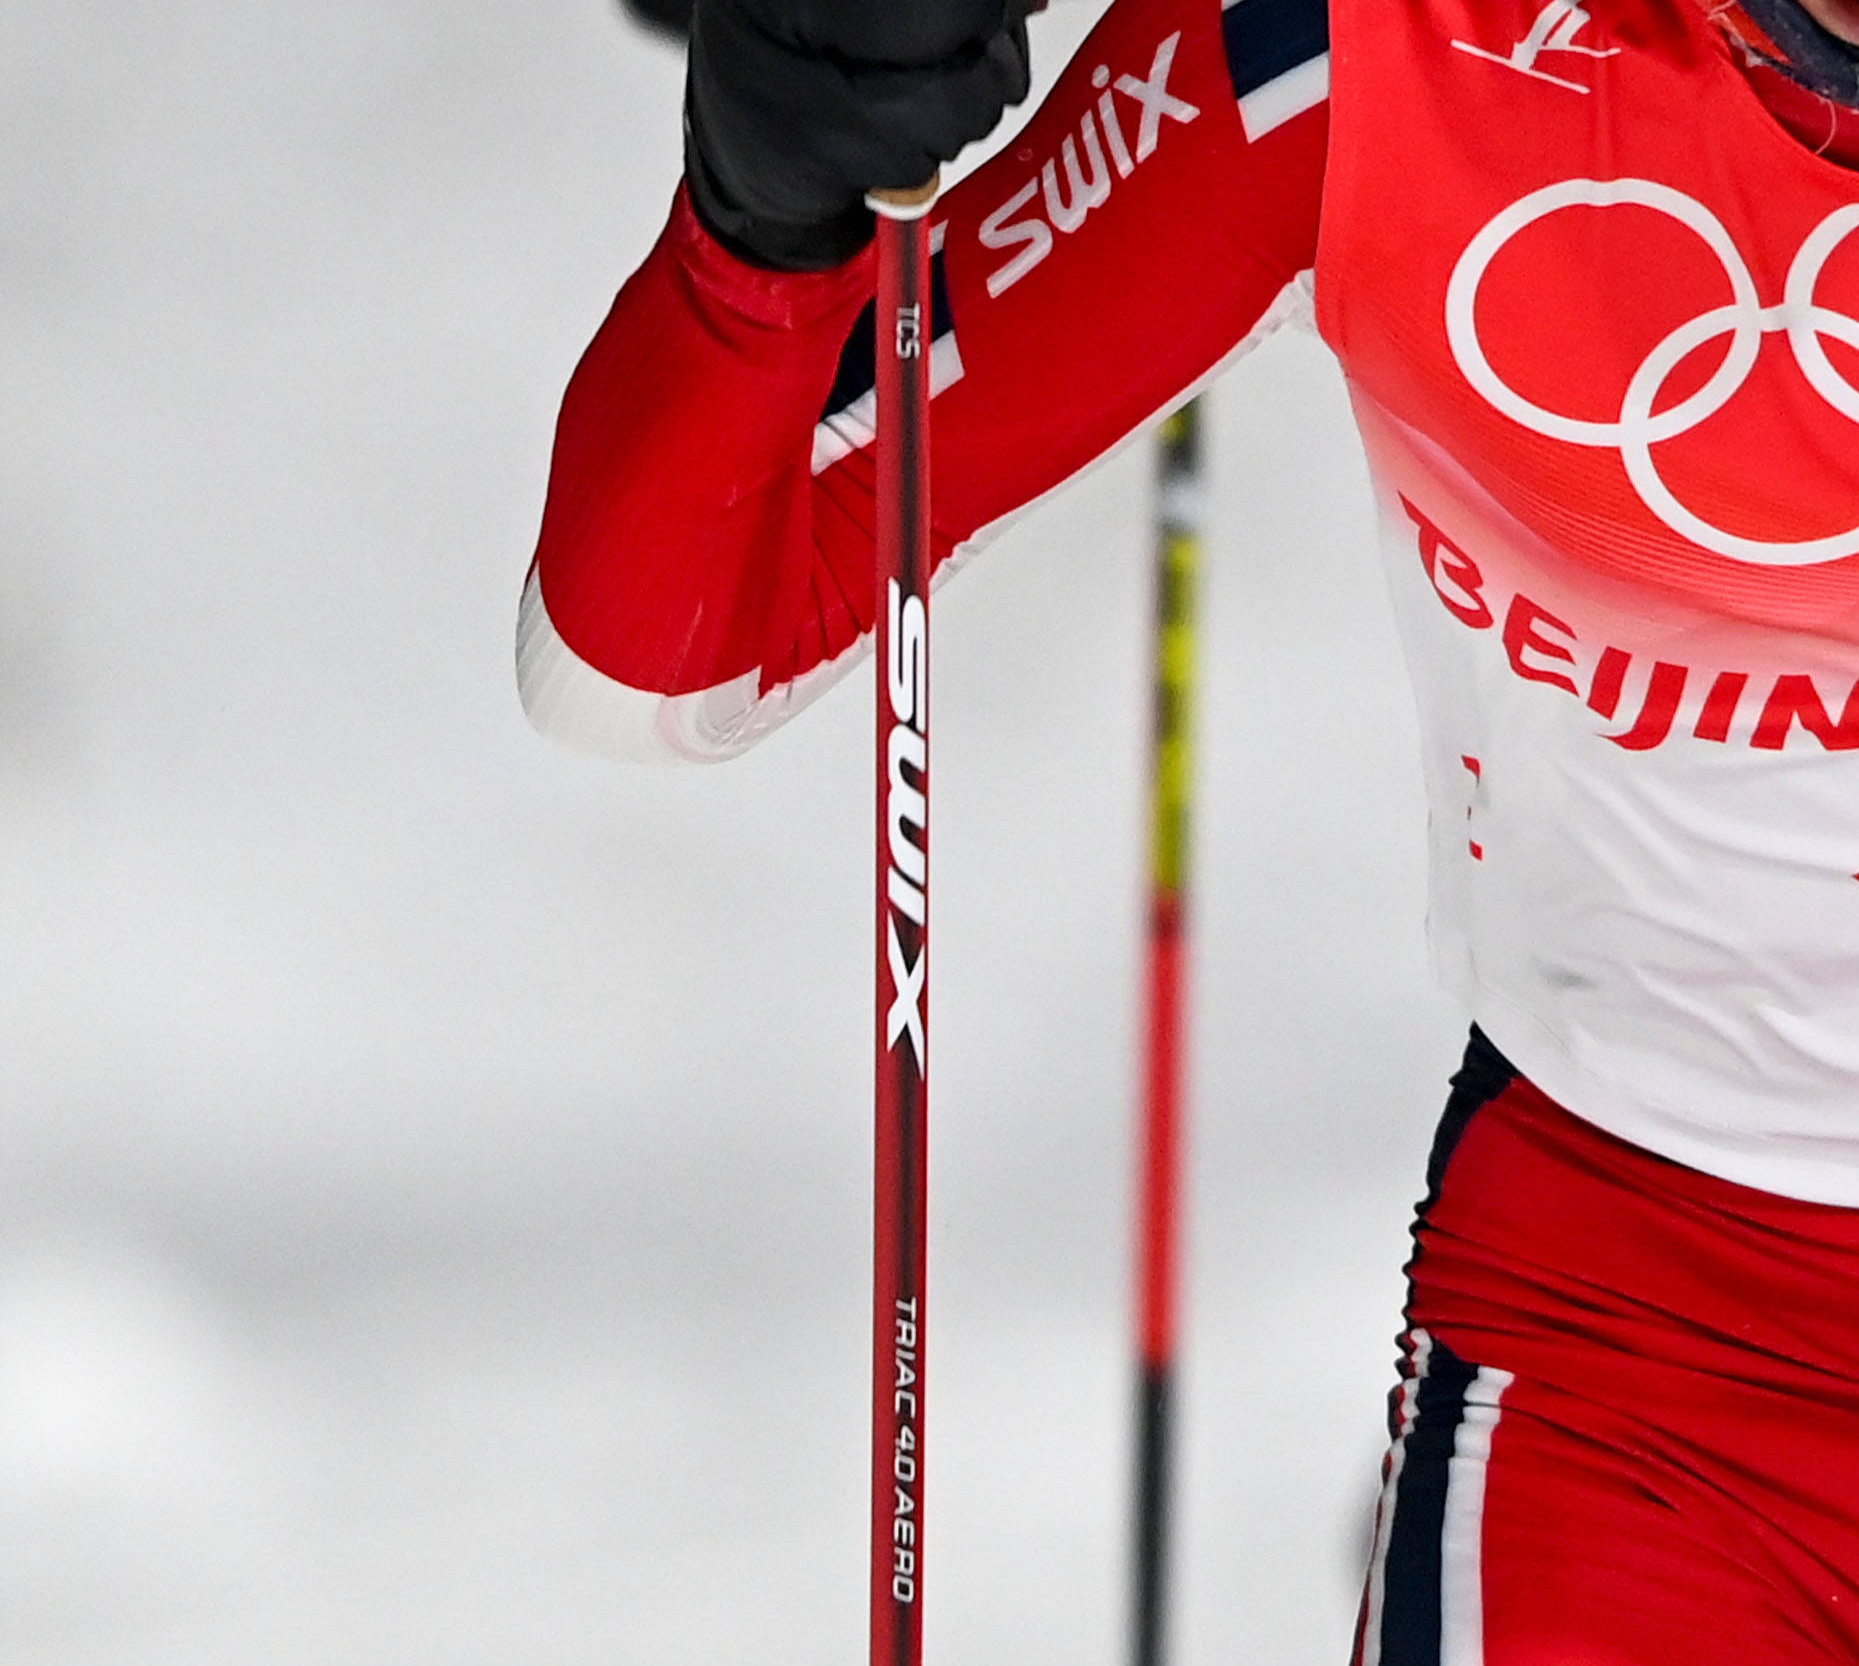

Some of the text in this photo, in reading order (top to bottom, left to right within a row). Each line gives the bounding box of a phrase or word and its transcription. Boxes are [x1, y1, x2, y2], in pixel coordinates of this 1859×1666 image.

[978, 30, 1201, 300] swix
[893, 1297, 917, 1417] TRIAC
[893, 1487, 917, 1602] AERO
